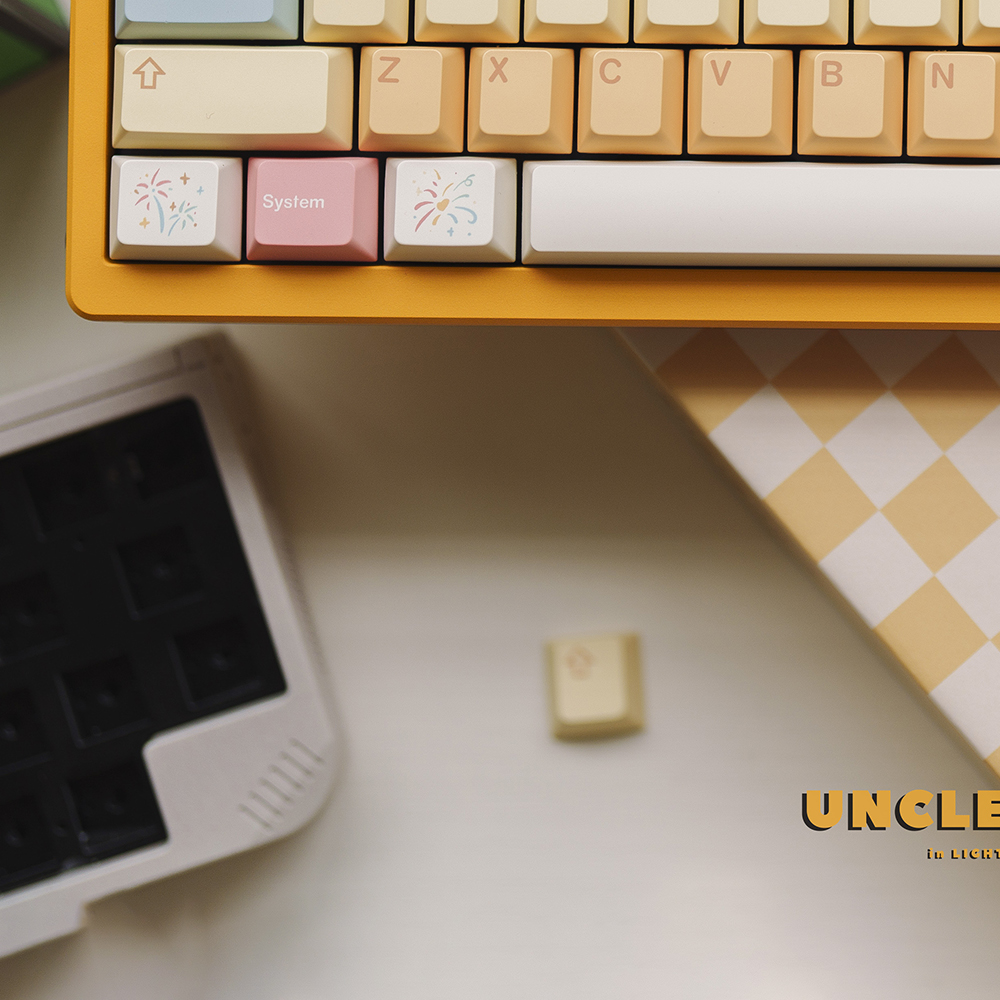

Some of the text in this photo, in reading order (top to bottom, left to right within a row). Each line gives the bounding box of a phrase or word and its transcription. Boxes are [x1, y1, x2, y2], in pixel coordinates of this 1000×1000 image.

[377, 55, 401, 84] Z
[488, 56, 509, 84] X
[599, 57, 622, 85] C
[710, 59, 732, 87] V
[820, 60, 843, 87] B
[931, 61, 955, 90] N
[262, 193, 325, 212] System
